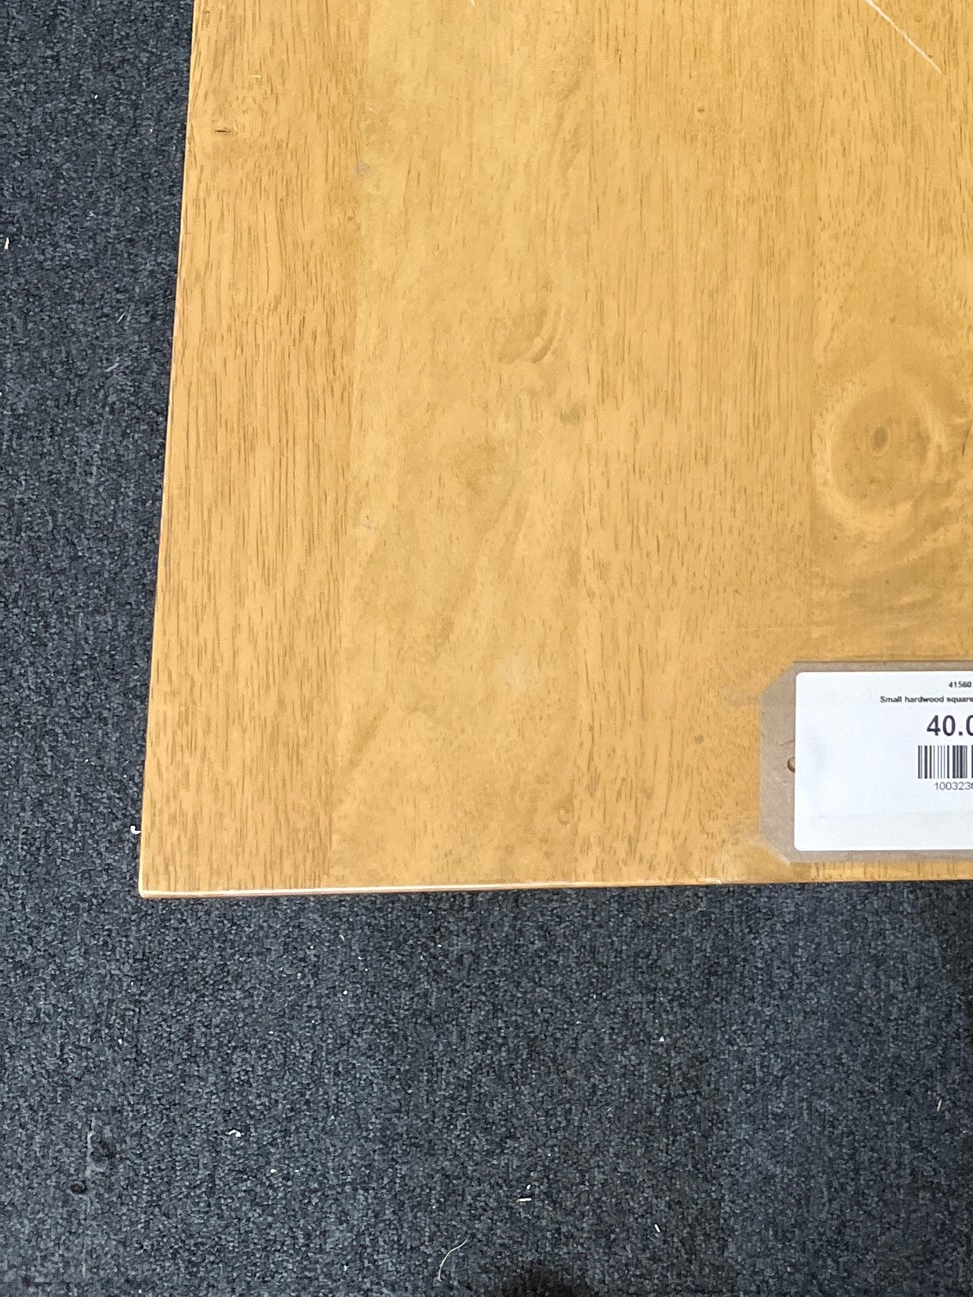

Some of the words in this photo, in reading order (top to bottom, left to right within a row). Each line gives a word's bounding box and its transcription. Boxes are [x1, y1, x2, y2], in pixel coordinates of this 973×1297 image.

[880, 695, 902, 703] Small
[905, 695, 944, 703] hardwood
[946, 696, 973, 704] square
